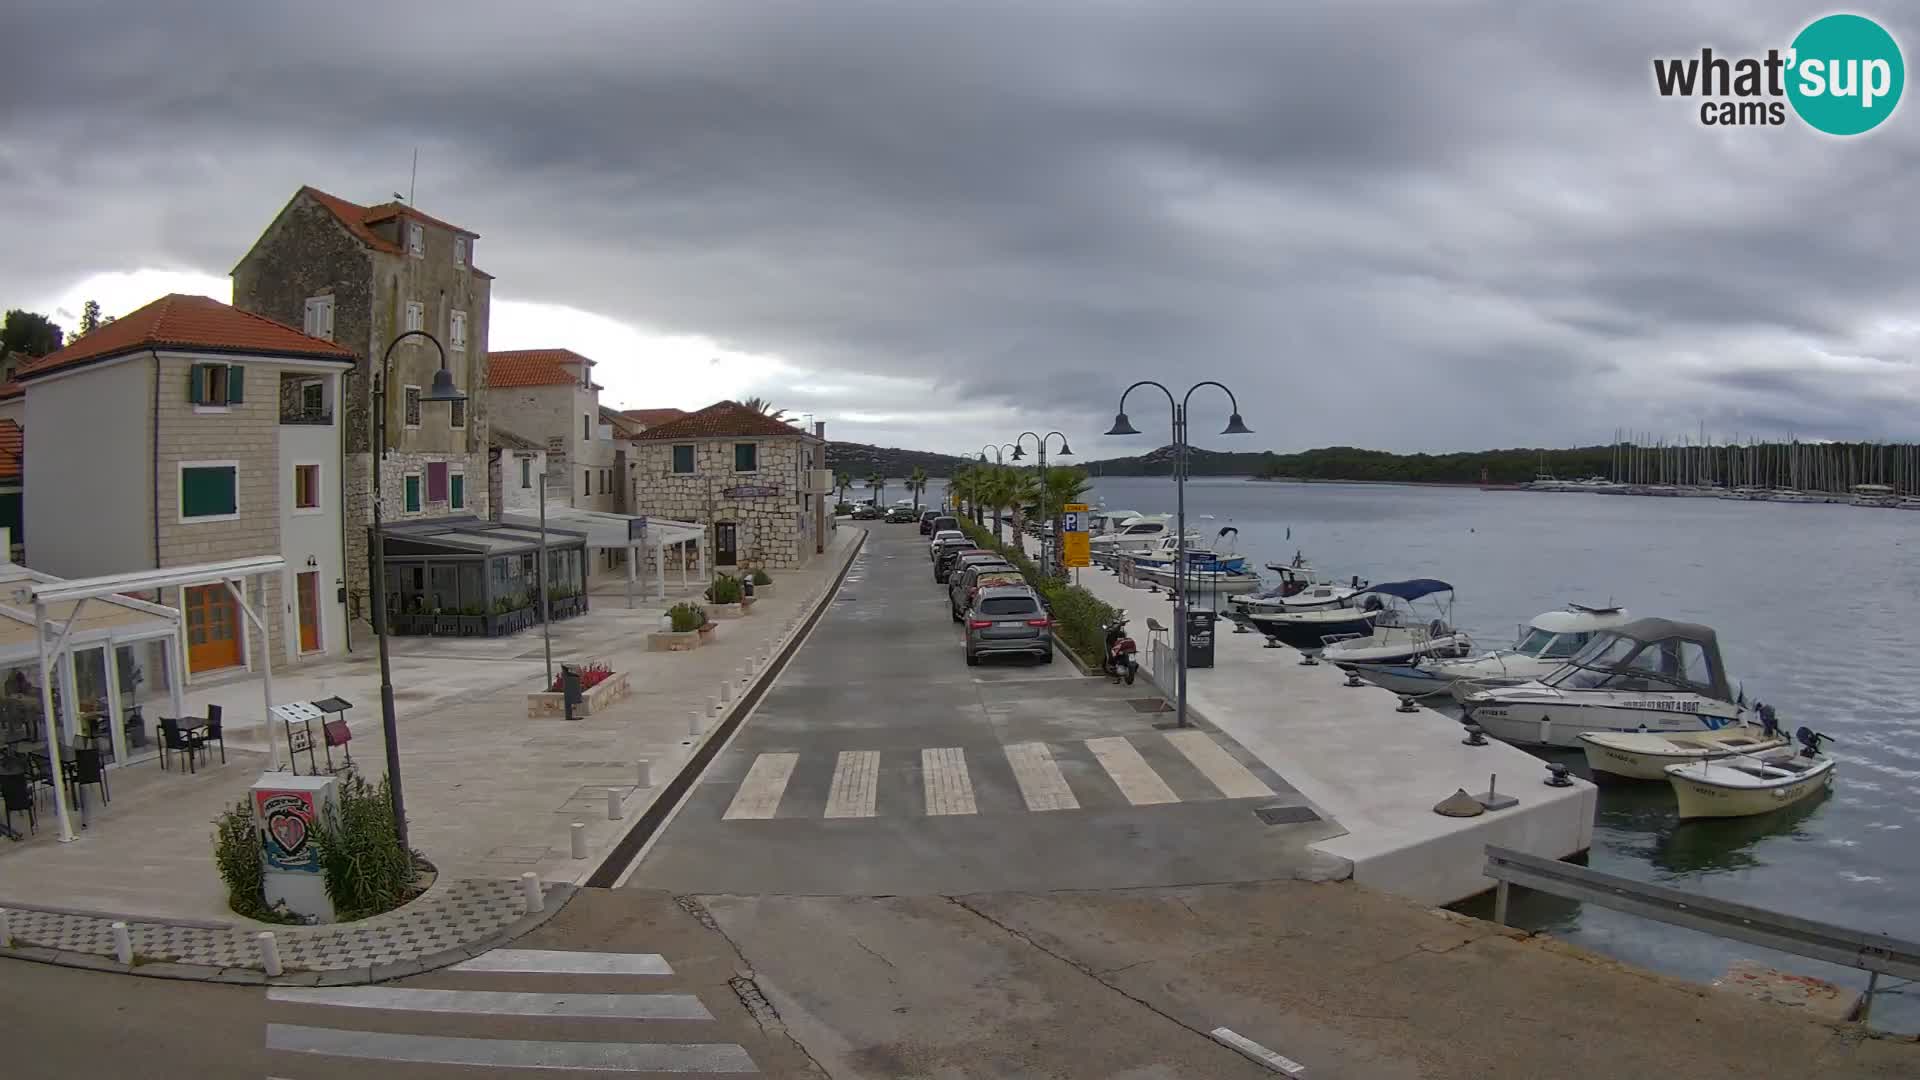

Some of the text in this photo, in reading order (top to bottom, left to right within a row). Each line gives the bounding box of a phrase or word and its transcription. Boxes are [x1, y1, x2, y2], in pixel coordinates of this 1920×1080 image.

[1066, 514, 1076, 530] P
[1656, 701, 1675, 710] RENT
[1676, 701, 1681, 711] A
[1682, 701, 1700, 712] BOAT
